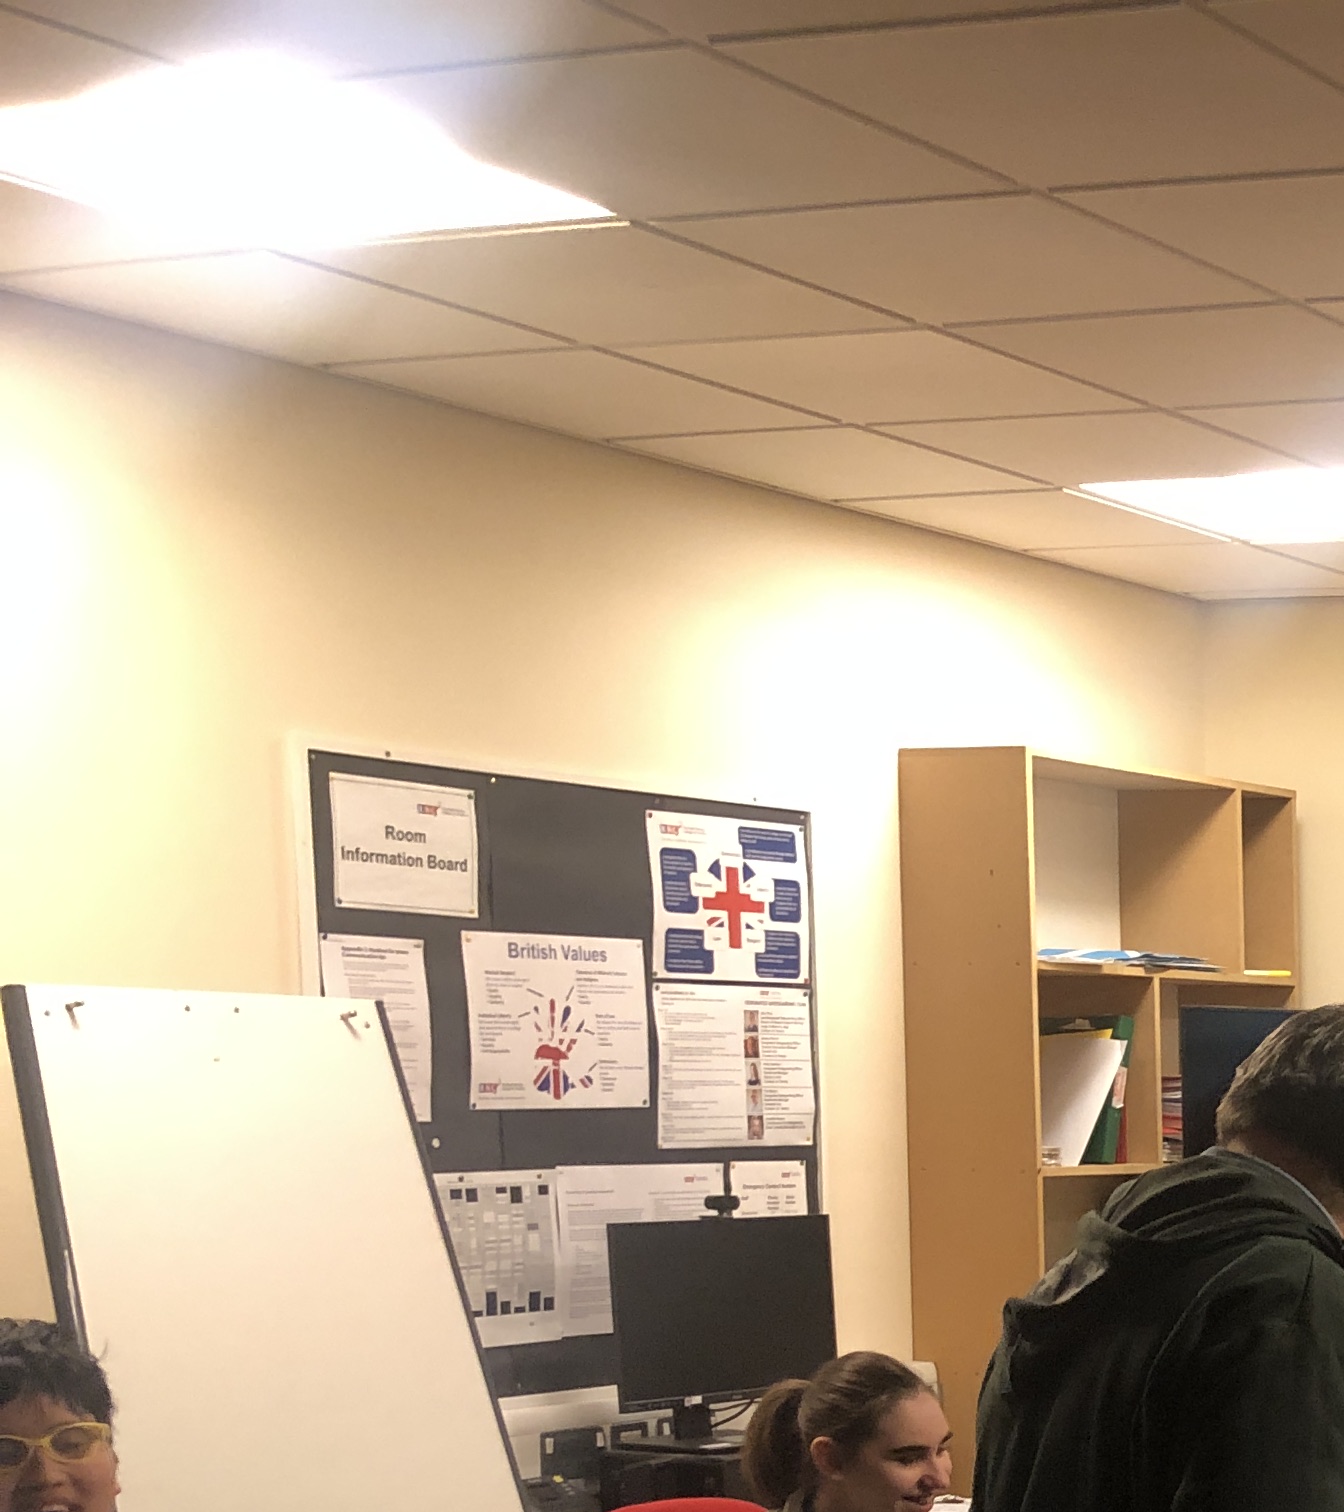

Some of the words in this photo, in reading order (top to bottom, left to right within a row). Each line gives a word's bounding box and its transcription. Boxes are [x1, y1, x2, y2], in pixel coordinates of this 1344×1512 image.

[384, 824, 427, 844] Room
[341, 845, 424, 868] Information
[427, 854, 468, 873] Board
[507, 941, 557, 960] British
[560, 944, 608, 963] Values
